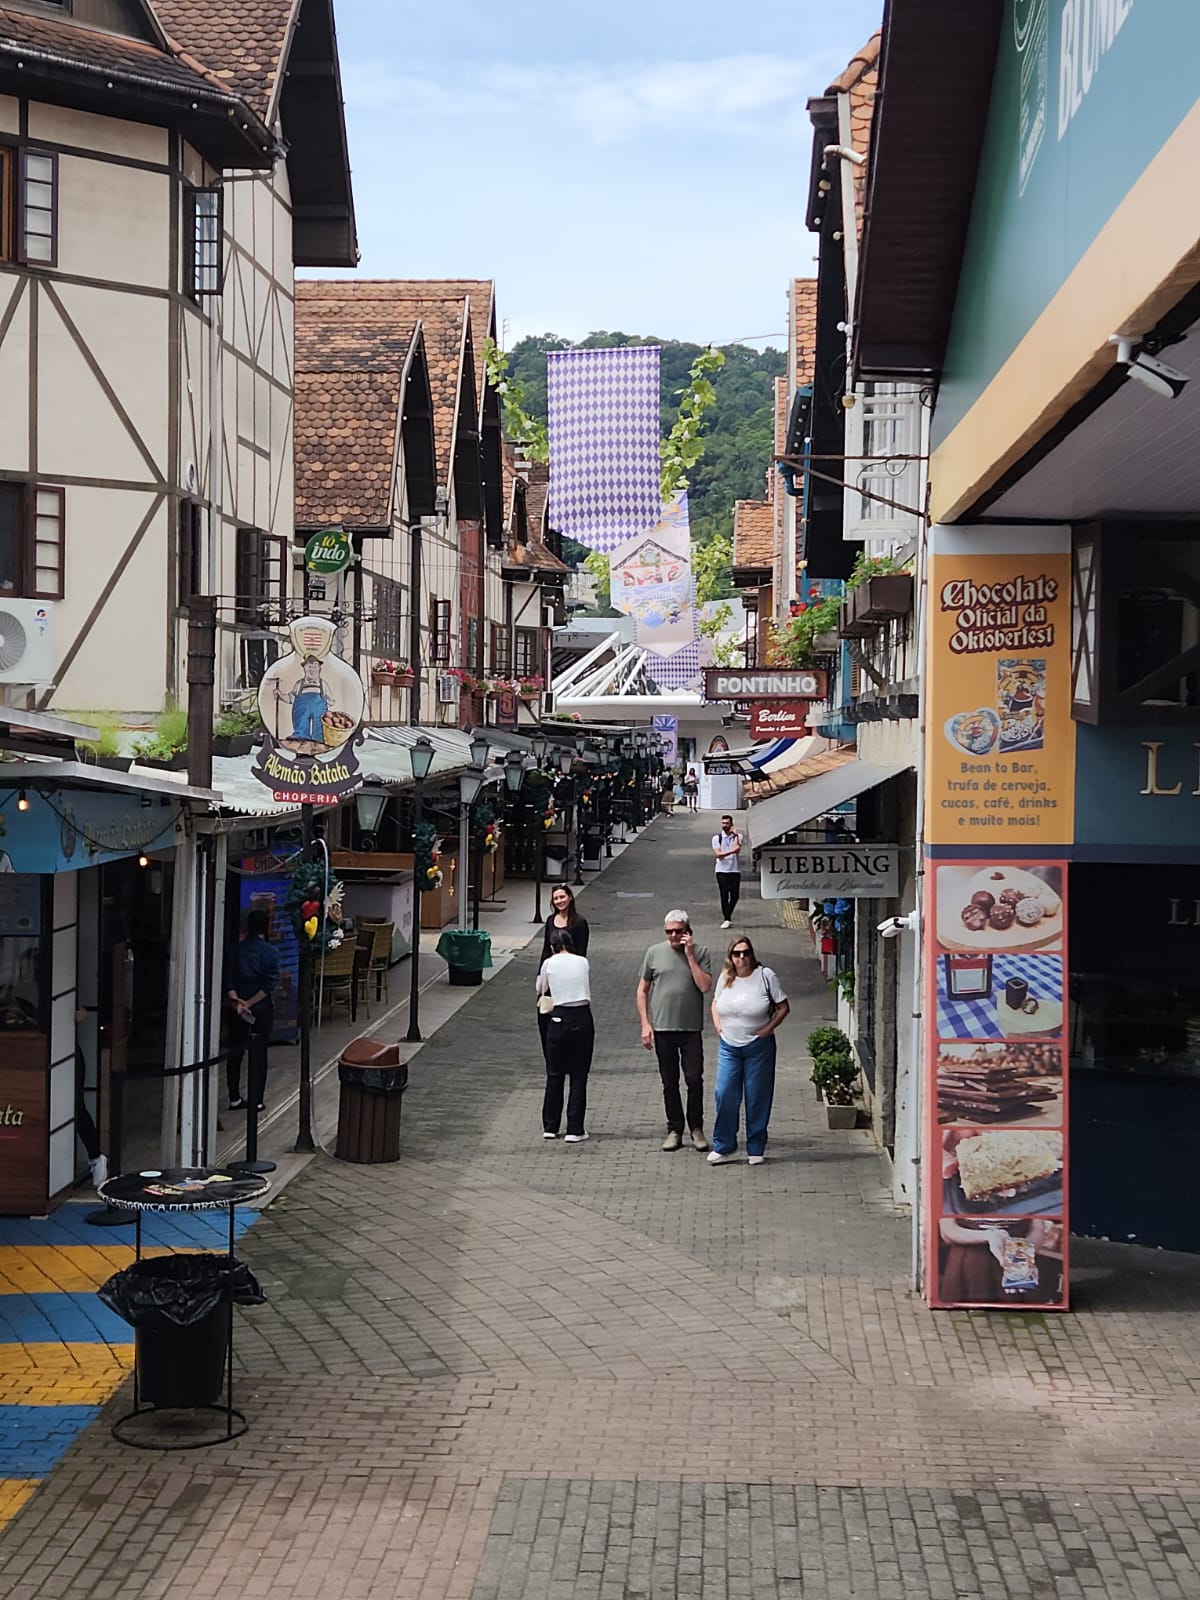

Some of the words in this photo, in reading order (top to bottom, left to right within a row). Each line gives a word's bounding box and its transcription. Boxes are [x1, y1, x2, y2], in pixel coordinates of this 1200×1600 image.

[311, 542, 345, 560] indo
[942, 576, 1057, 608] Chocolate
[958, 605, 1016, 628] Oficial
[1024, 604, 1045, 622] da
[950, 625, 1053, 651] Oktoberfest
[717, 676, 816, 694] PONTINHO
[263, 753, 306, 785] Alemão
[309, 761, 350, 786] Batata
[960, 762, 991, 773] Bean
[995, 762, 1008, 773] to
[947, 779, 979, 791] trufa
[983, 780, 997, 791] de
[274, 791, 338, 804] CHOPERIA
[1018, 797, 1057, 808] drinks
[958, 816, 965, 826] e
[969, 814, 1003, 826] muito
[1008, 814, 1041, 826] mais!
[769, 851, 890, 876] LIEBLING
